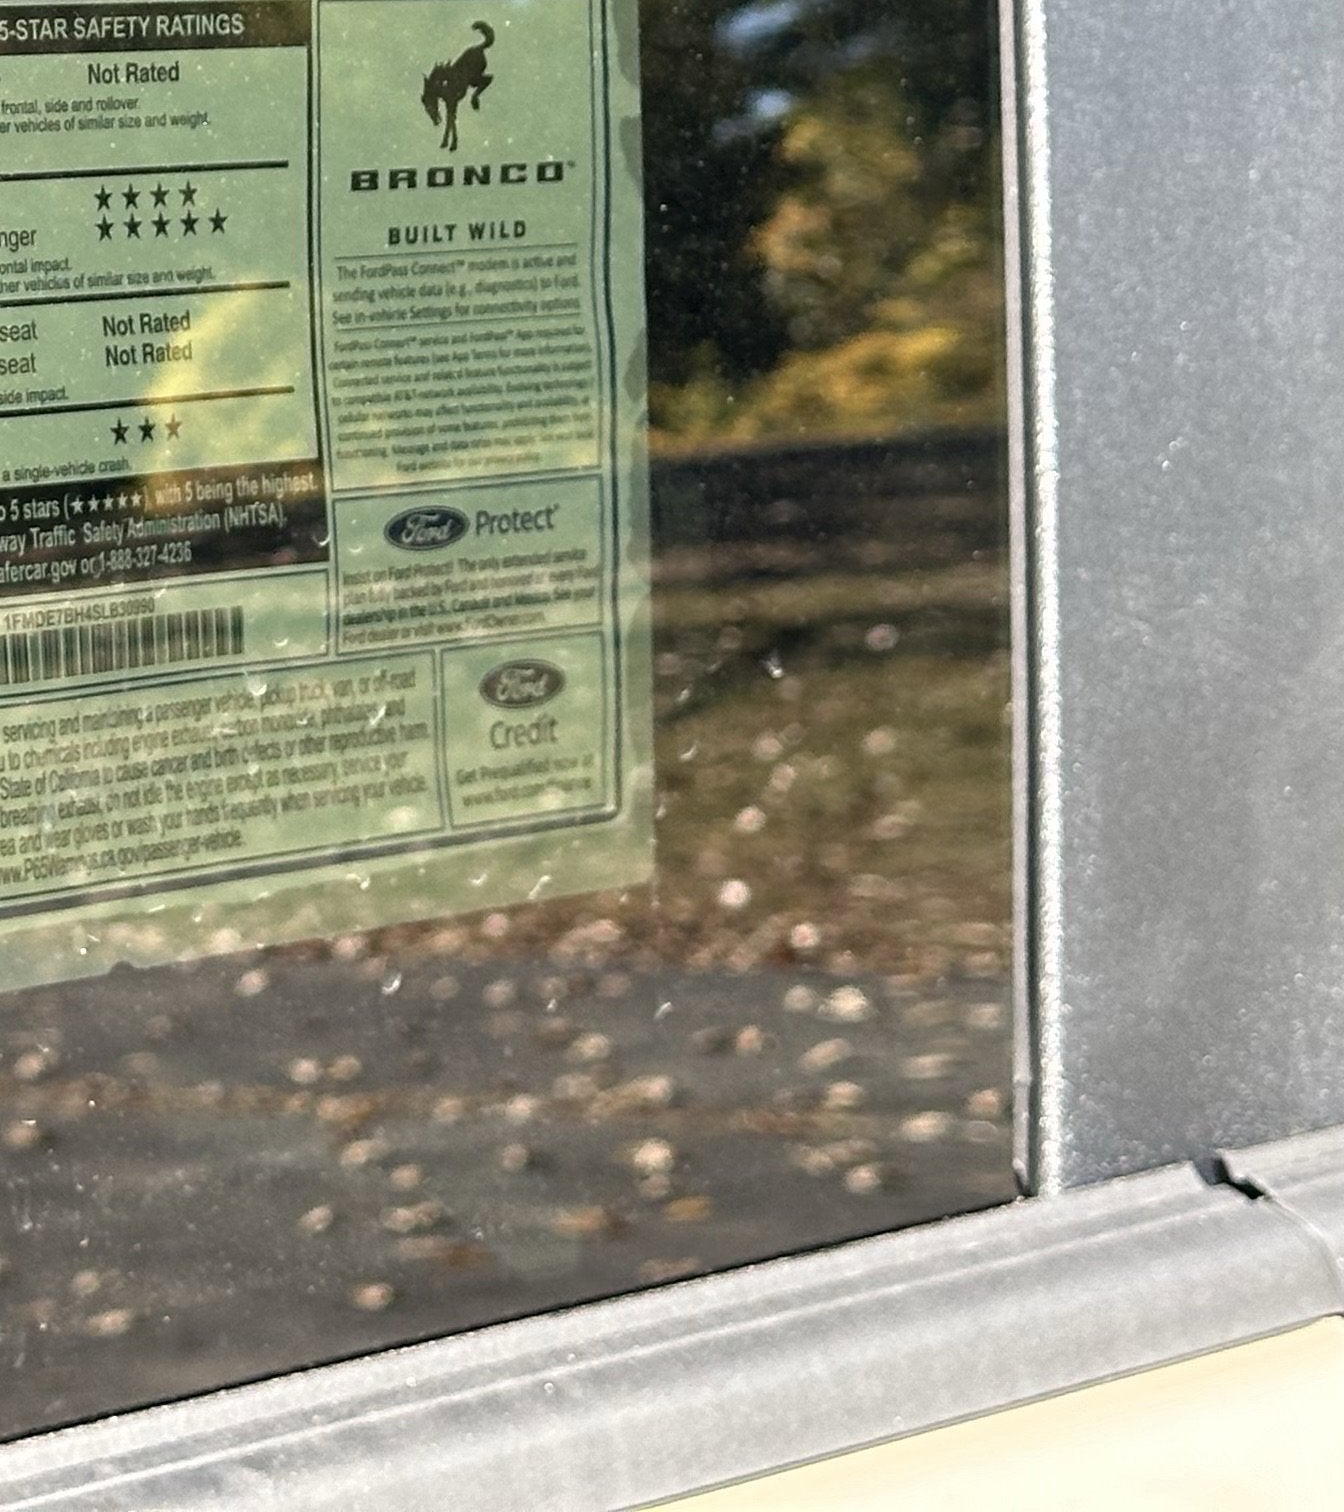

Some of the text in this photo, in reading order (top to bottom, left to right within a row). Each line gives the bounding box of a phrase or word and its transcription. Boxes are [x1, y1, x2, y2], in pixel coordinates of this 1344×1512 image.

[73, 16, 150, 39] SAFETY
[155, 14, 245, 36] RATINGS
[87, 62, 180, 84] Not Rated
[350, 161, 564, 192] BRONCO
[388, 221, 527, 246] BUILT WILD
[401, 514, 452, 543] Ford
